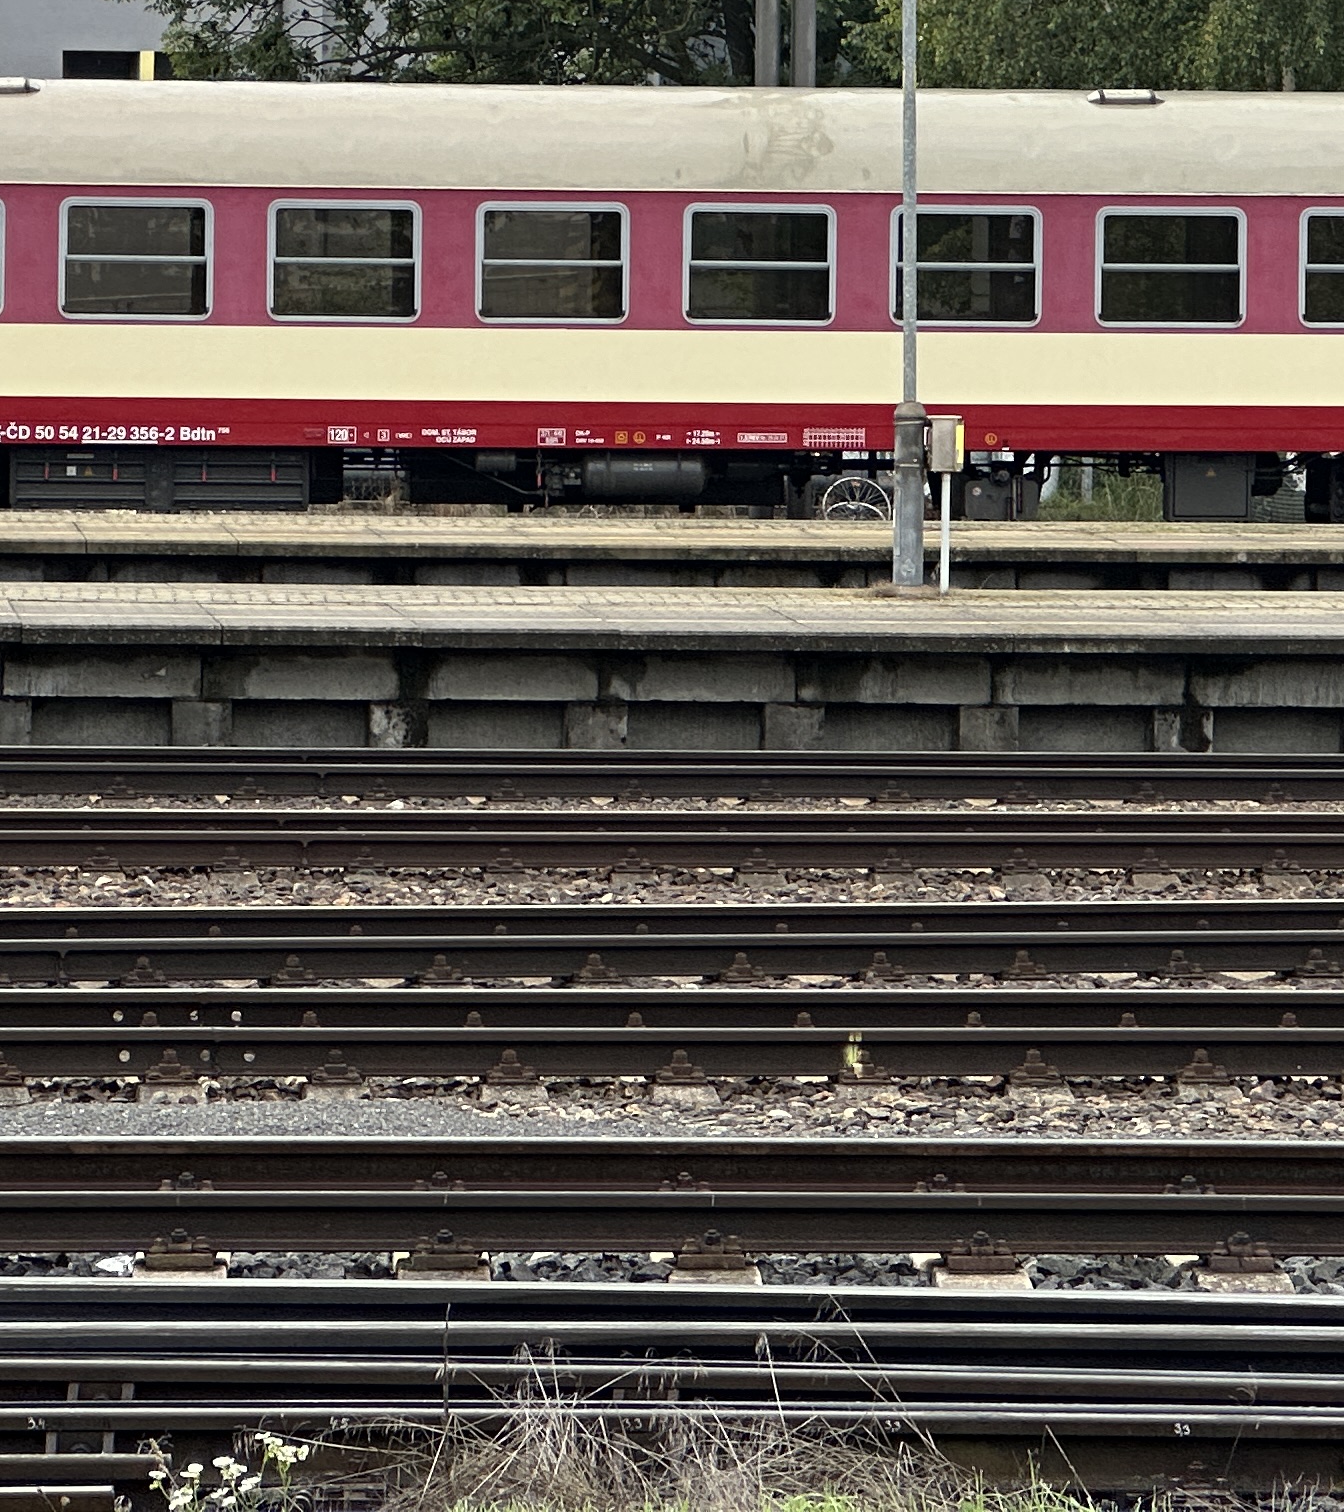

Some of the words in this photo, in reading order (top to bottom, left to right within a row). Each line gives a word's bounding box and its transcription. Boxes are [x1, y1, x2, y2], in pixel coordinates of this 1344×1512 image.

[34, 425, 55, 440] 50
[58, 425, 79, 440] 54
[82, 425, 127, 441] 21-29
[129, 426, 175, 441] 356-2
[329, 428, 349, 441] 120
